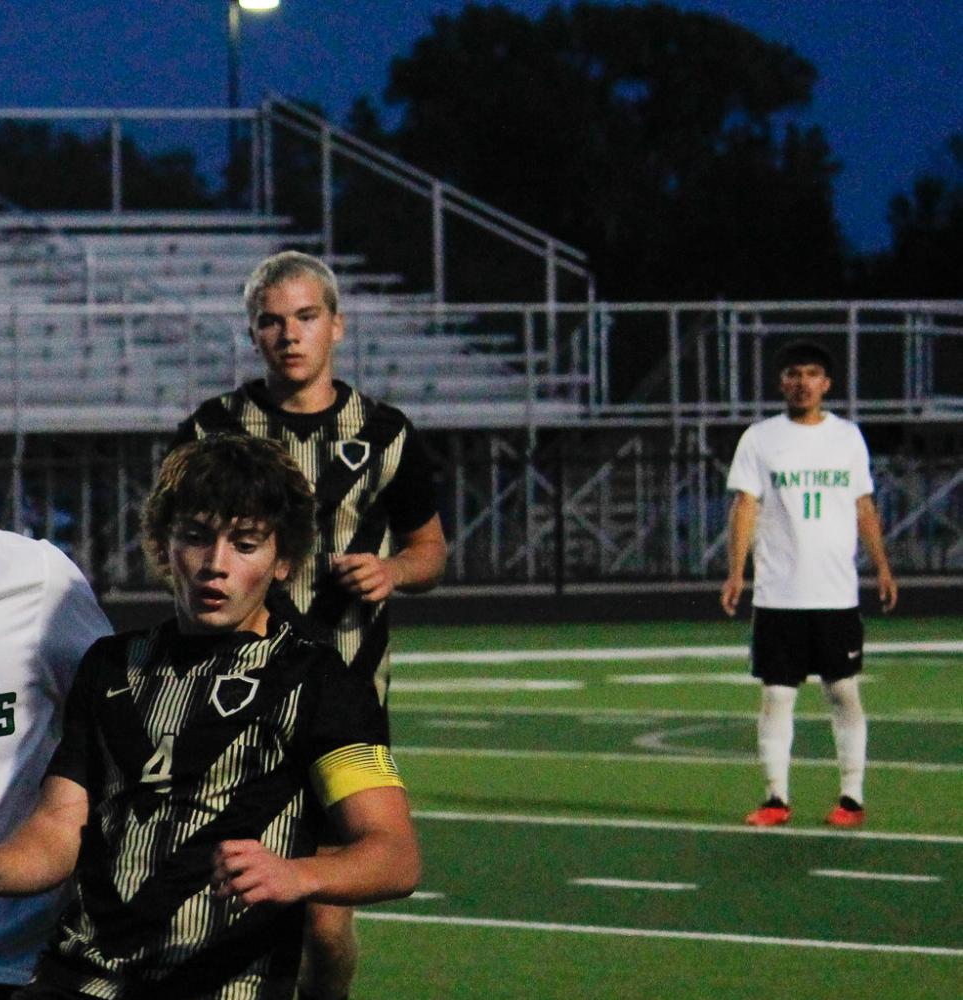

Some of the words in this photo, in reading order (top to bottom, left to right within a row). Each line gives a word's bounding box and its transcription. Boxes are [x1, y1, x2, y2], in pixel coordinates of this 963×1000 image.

[770, 470, 850, 489] PANTHERS
[803, 492, 821, 519] 11
[140, 734, 174, 794] 4
